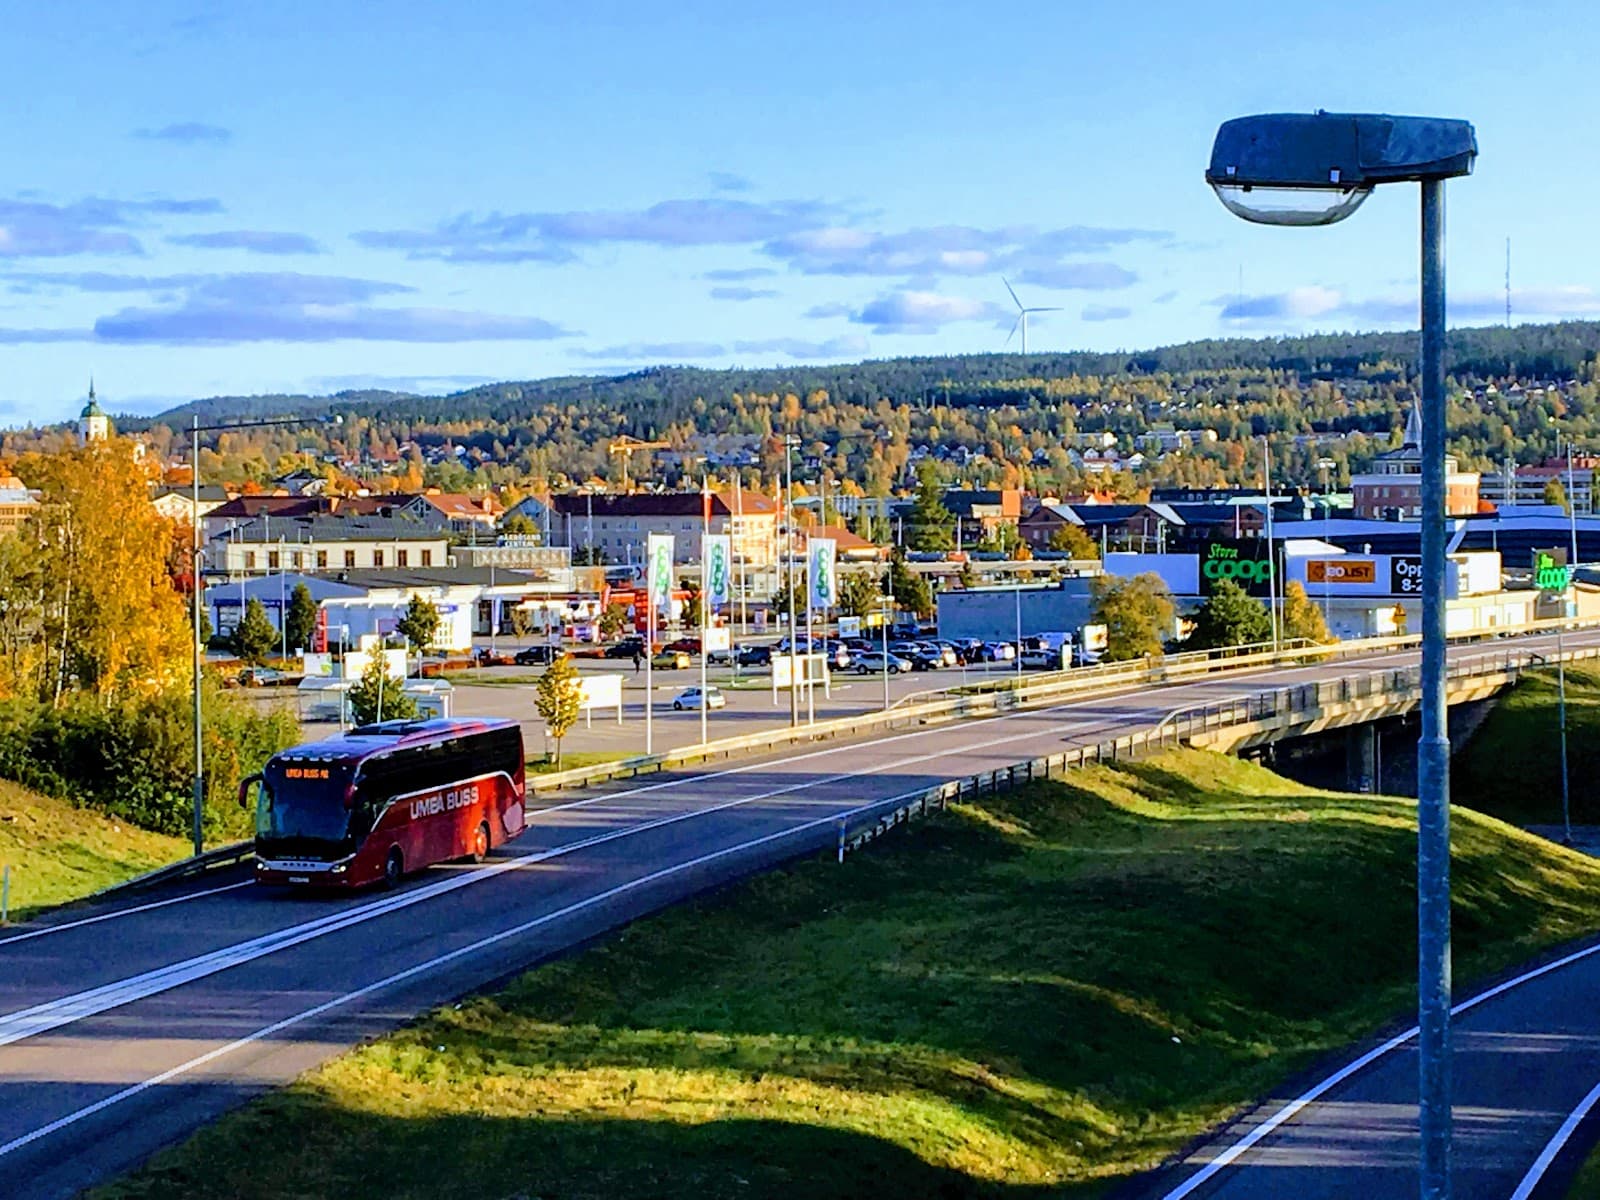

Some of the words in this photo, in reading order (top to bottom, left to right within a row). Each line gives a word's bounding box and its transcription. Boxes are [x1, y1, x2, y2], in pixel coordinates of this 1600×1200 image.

[1207, 543, 1239, 559] Stora
[816, 547, 829, 599] coop
[1203, 559, 1277, 584] coop
[1395, 559, 1423, 577] Öpp
[1539, 568, 1567, 591] coop
[1401, 578, 1423, 592] 8-2
[446, 785, 479, 810] BUSS
